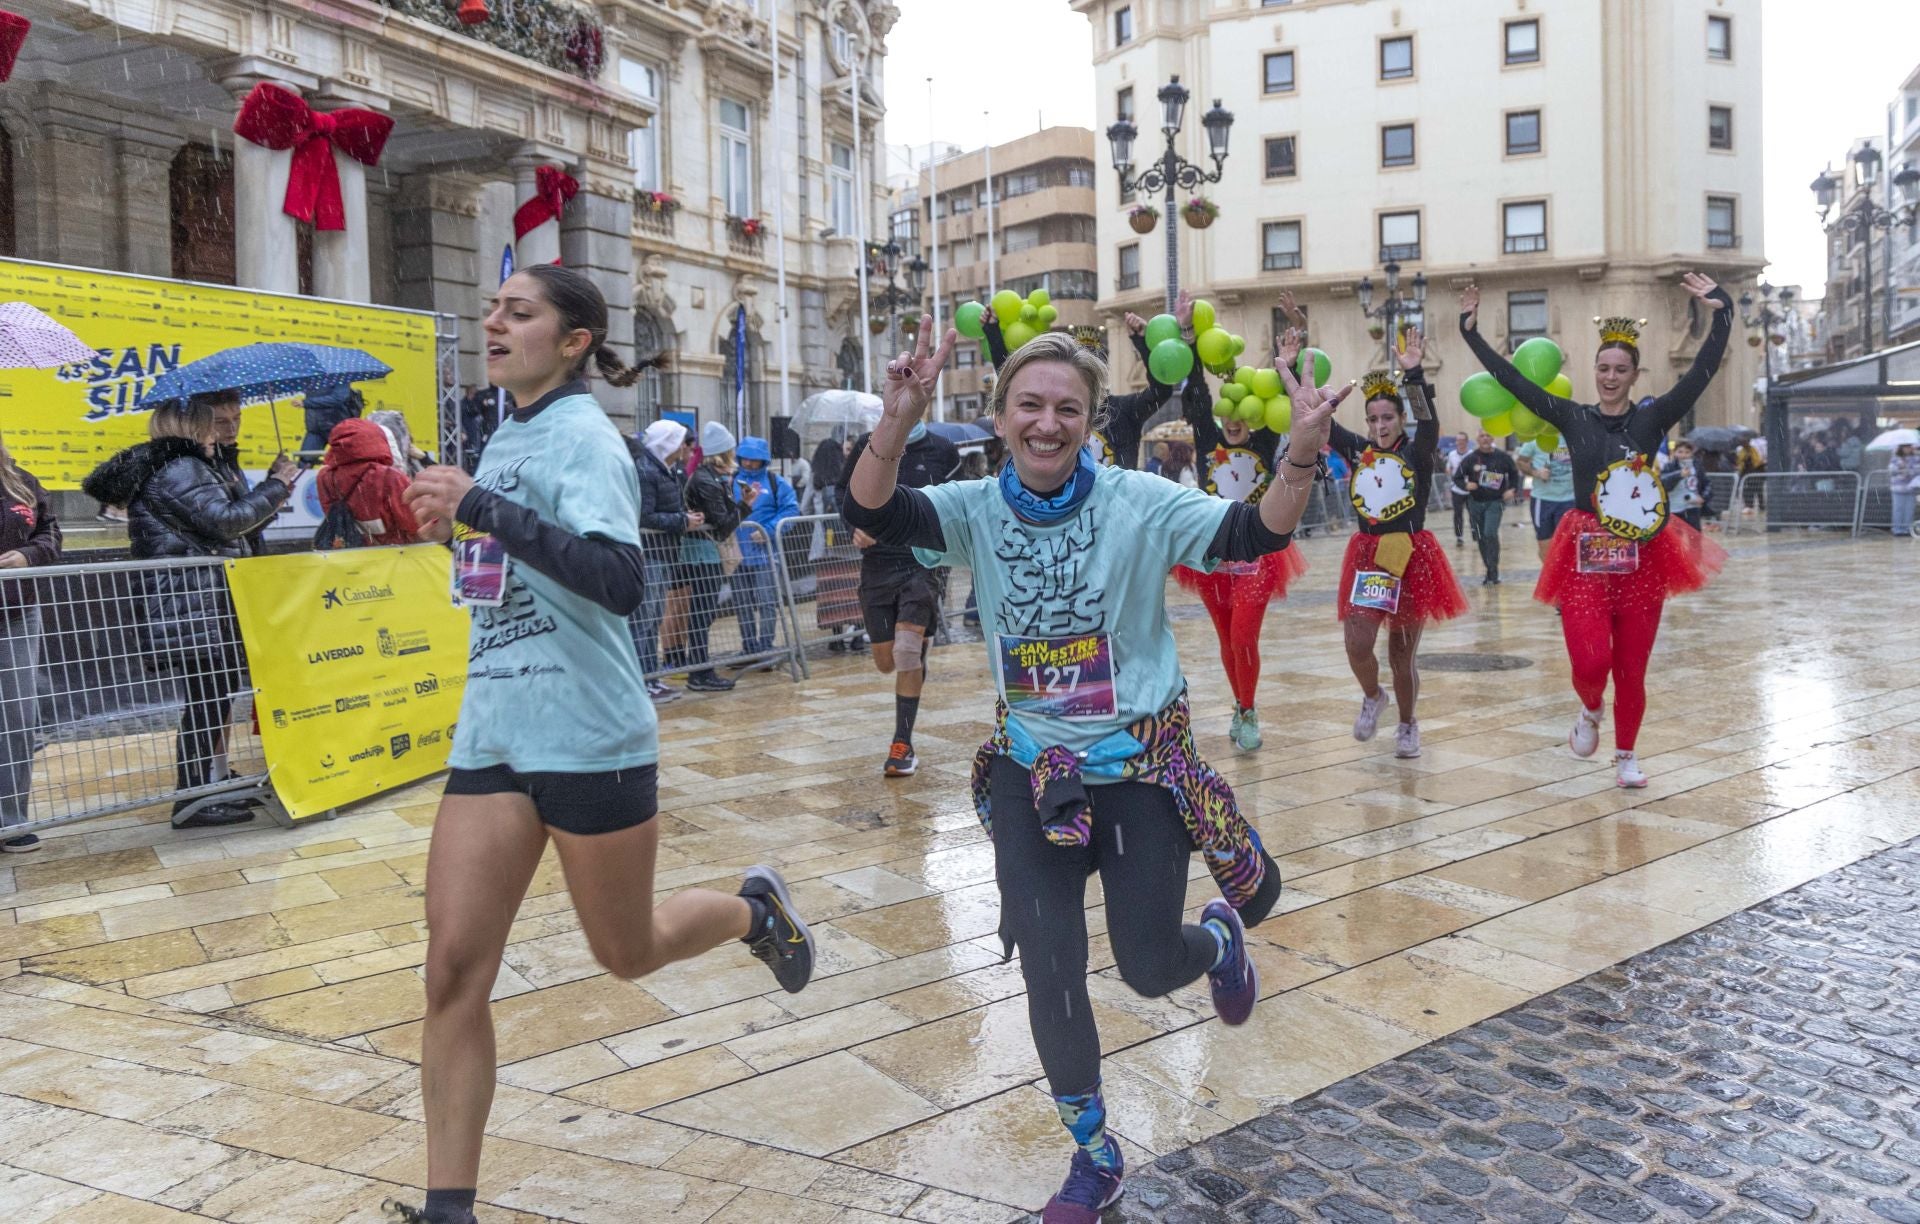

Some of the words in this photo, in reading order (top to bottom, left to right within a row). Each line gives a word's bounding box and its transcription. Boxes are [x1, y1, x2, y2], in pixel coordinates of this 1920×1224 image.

[88, 343, 181, 383] SAN
[1381, 496, 1414, 519] 2025
[995, 505, 1096, 569] SAN
[1601, 515, 1641, 538] 2025
[1589, 548, 1627, 562] 2250
[342, 584, 394, 602] CaixaBank
[1003, 560, 1089, 607] SIL
[1362, 585, 1392, 600] 3000
[308, 650, 324, 664] LA
[323, 645, 364, 661] VERDAD
[1020, 641, 1048, 655] SAN
[1021, 637, 1098, 667] SILVESTRE
[414, 678, 439, 695] DSM
[1027, 664, 1081, 693] 127
